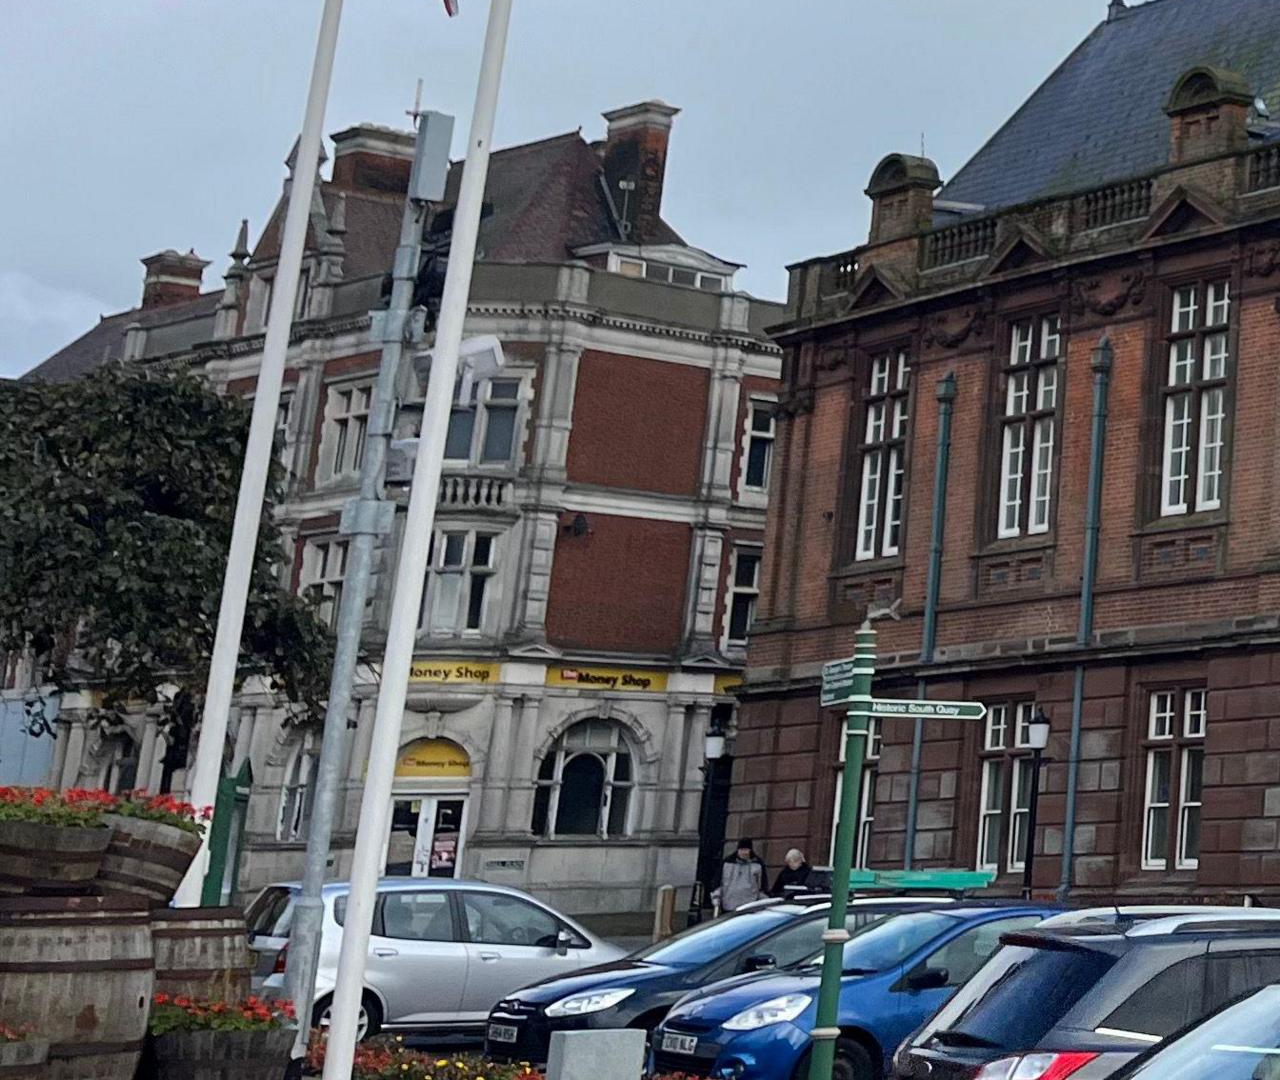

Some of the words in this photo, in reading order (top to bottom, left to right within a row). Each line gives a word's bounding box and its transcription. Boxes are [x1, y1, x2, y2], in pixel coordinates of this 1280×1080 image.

[455, 666, 490, 682] Shop
[578, 673, 618, 688] Money
[621, 674, 651, 688] Shop
[872, 702, 906, 712] Historic
[908, 703, 935, 714] South
[936, 705, 960, 717] Quay
